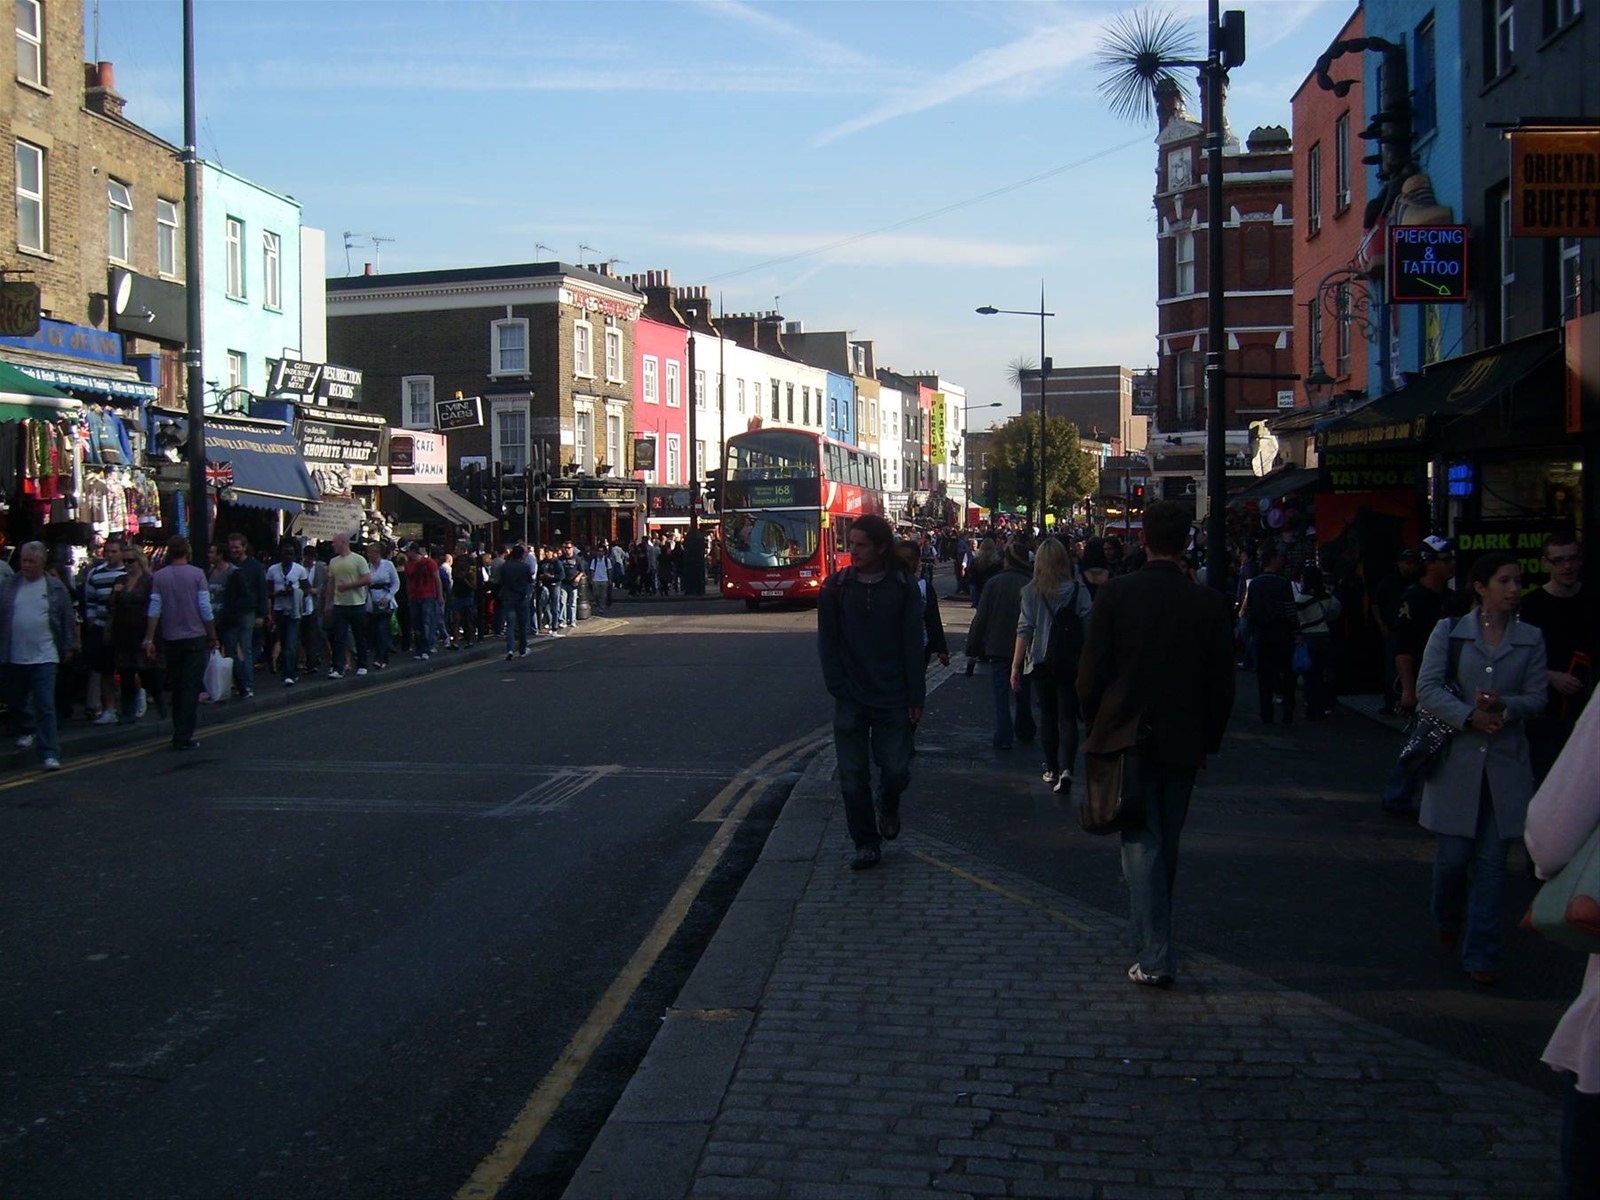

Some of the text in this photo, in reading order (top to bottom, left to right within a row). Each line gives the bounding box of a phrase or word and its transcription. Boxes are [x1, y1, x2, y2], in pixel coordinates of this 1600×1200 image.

[1524, 153, 1600, 184] ORIENTA
[1395, 229, 1464, 245] PIERCING
[1423, 246, 1435, 261] &
[1400, 260, 1460, 275] TATTOO
[323, 365, 363, 385] RESURRECTION
[329, 382, 354, 399] RECORDS
[445, 401, 469, 412] MINI
[440, 408, 474, 421] CABS
[304, 442, 341, 458] SHOPRITE
[342, 446, 371, 460] MARKET
[416, 439, 434, 453] CAFE
[775, 485, 791, 496] 168
[1458, 533, 1513, 551] DARK
